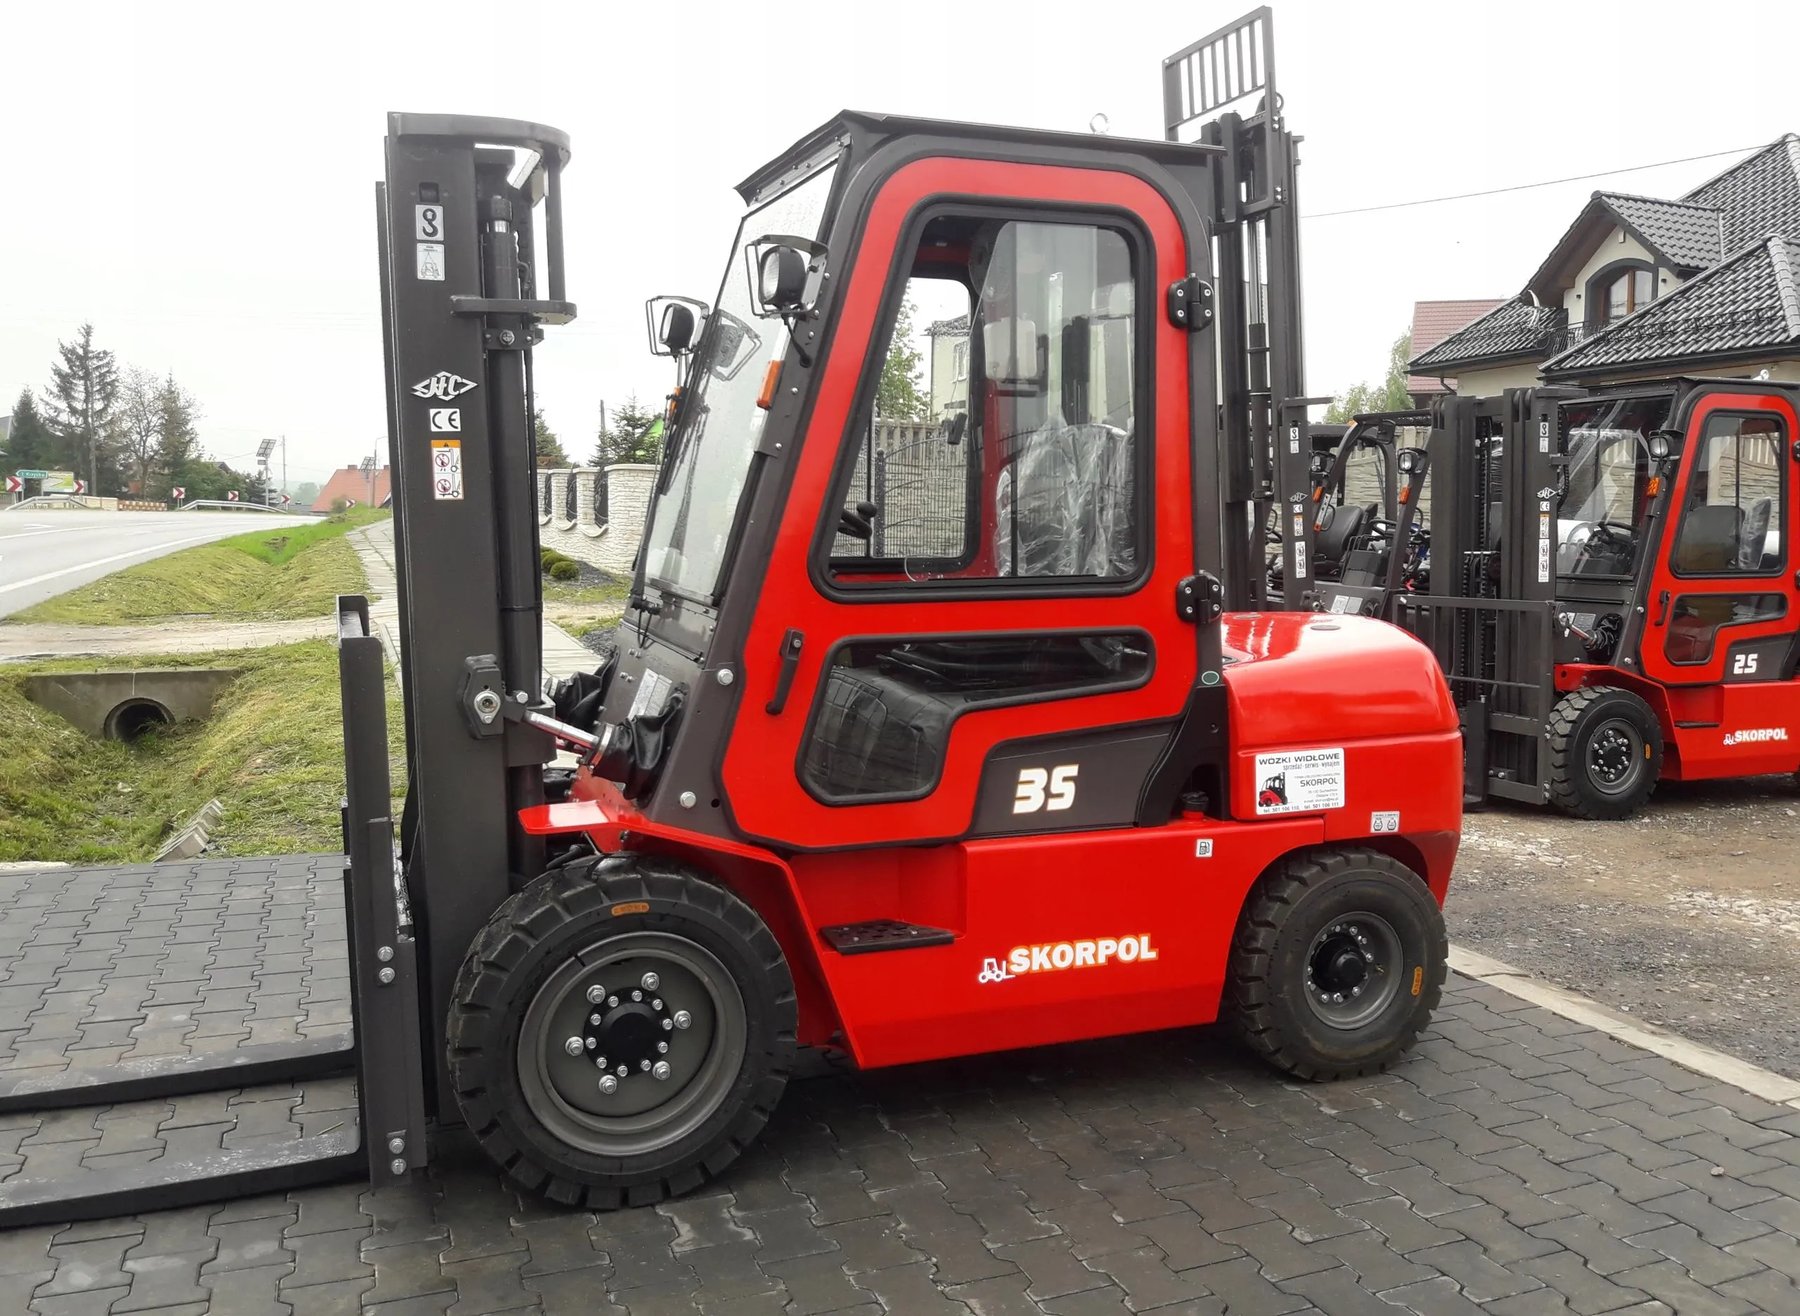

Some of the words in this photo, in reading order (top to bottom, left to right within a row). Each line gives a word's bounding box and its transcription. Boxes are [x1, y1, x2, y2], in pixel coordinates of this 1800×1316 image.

[432, 411, 459, 429] CE
[1733, 653, 1758, 675] 25
[1735, 728, 1788, 742] SKORPOL
[1013, 763, 1080, 814] 35
[1300, 778, 1338, 787] SKORPOL
[1008, 935, 1158, 974] SKORPOL
